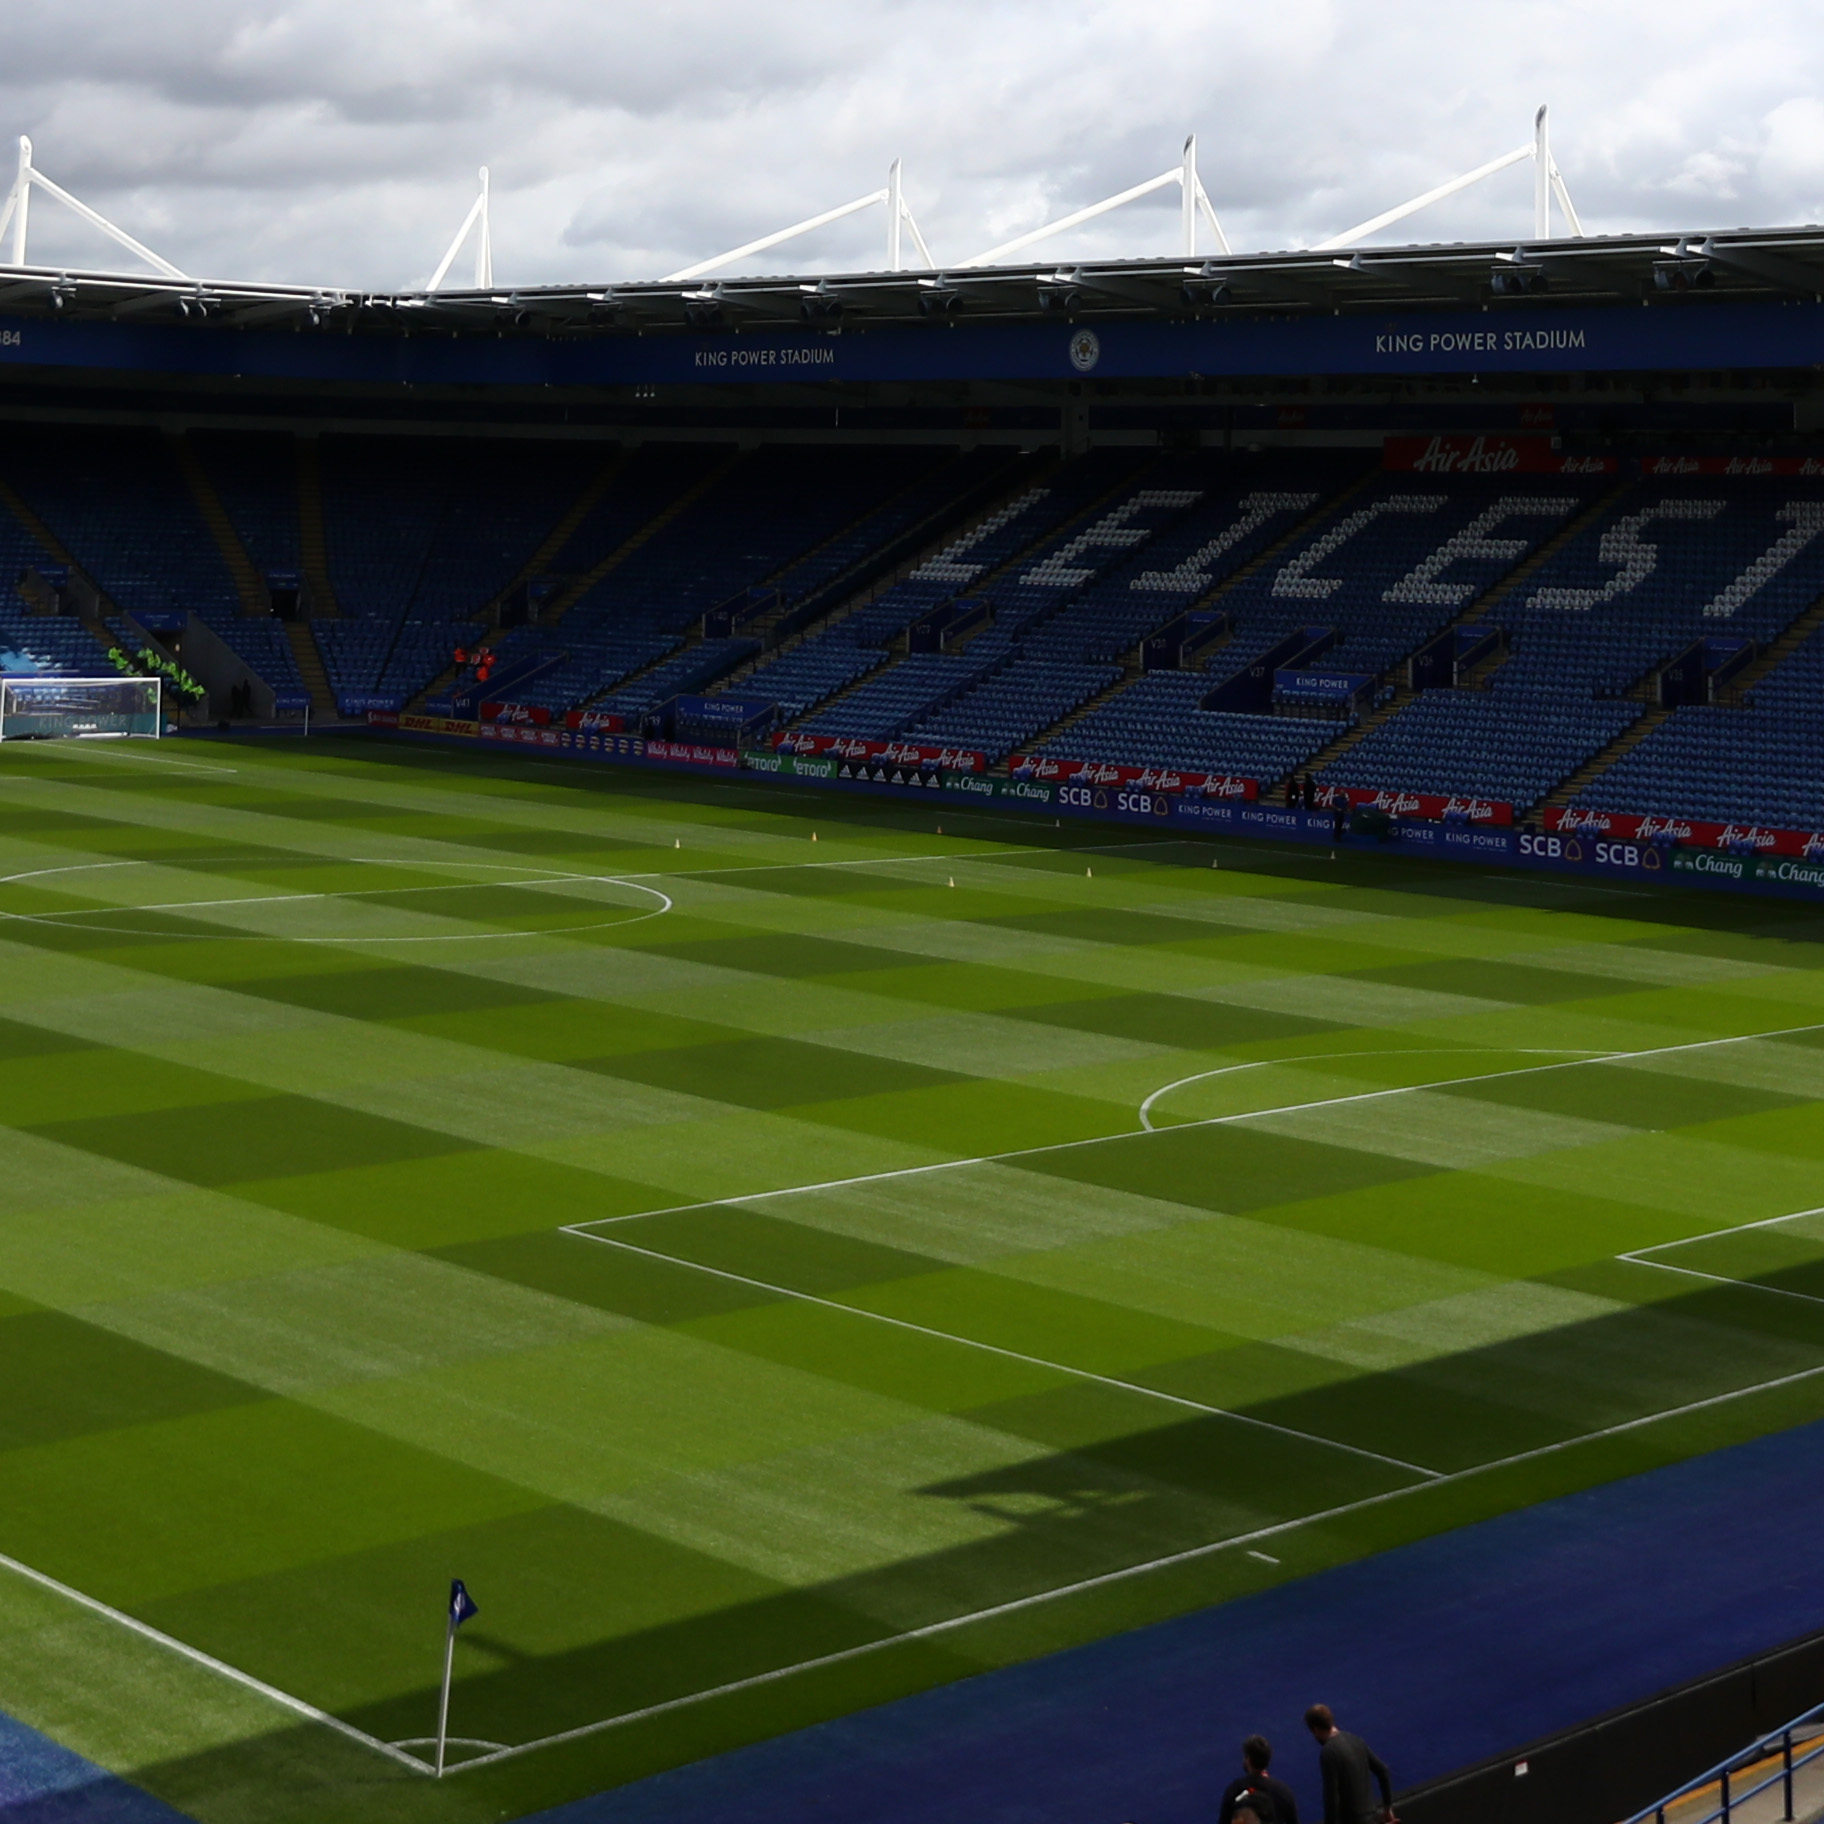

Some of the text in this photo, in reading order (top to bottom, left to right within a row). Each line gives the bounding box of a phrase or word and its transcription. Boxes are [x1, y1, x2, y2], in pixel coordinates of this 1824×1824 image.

[1376, 329, 1585, 353] KING POWER STADIUM
[695, 348, 834, 366] KING POWER STADIUM
[1296, 677, 1349, 689] KING POWER
[960, 776, 993, 796] Chang
[1016, 782, 1050, 803] Chang
[1059, 787, 1092, 807] SCB
[1117, 793, 1151, 814] SCB
[1178, 804, 1232, 819] KING POWER
[1242, 811, 1297, 826] KING POWER
[1307, 818, 1330, 829] KING
[1401, 827, 1434, 840] POWER
[1446, 832, 1508, 848] KING POWER
[1520, 834, 1561, 857] SCB
[1595, 843, 1639, 866] SCB
[1695, 854, 1743, 879] Chang
